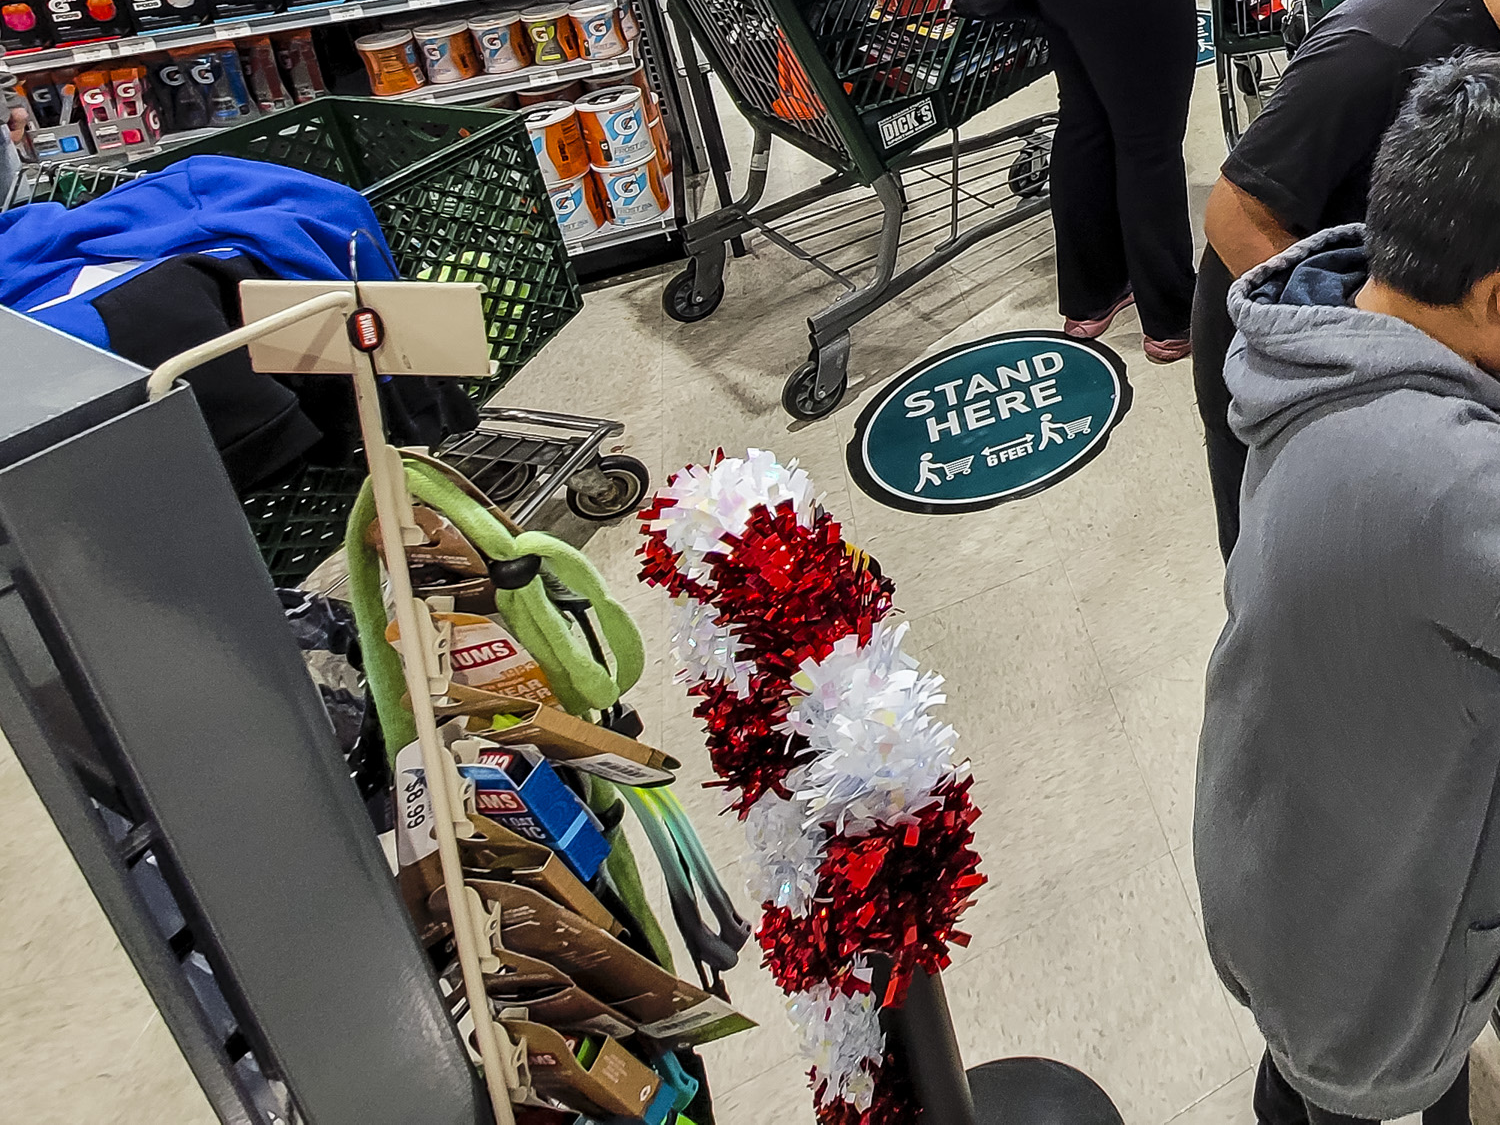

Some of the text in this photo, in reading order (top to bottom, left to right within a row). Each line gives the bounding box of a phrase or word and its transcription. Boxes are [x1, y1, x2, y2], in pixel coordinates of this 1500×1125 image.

[614, 110, 638, 135] G
[882, 105, 932, 141] DICK'S
[614, 174, 640, 198] G
[359, 314, 376, 344] CHUMS
[904, 352, 1064, 418] STAND
[926, 379, 1062, 443] HERE
[986, 442, 1034, 467] 6 FEET
[404, 779, 425, 830] $8.99
